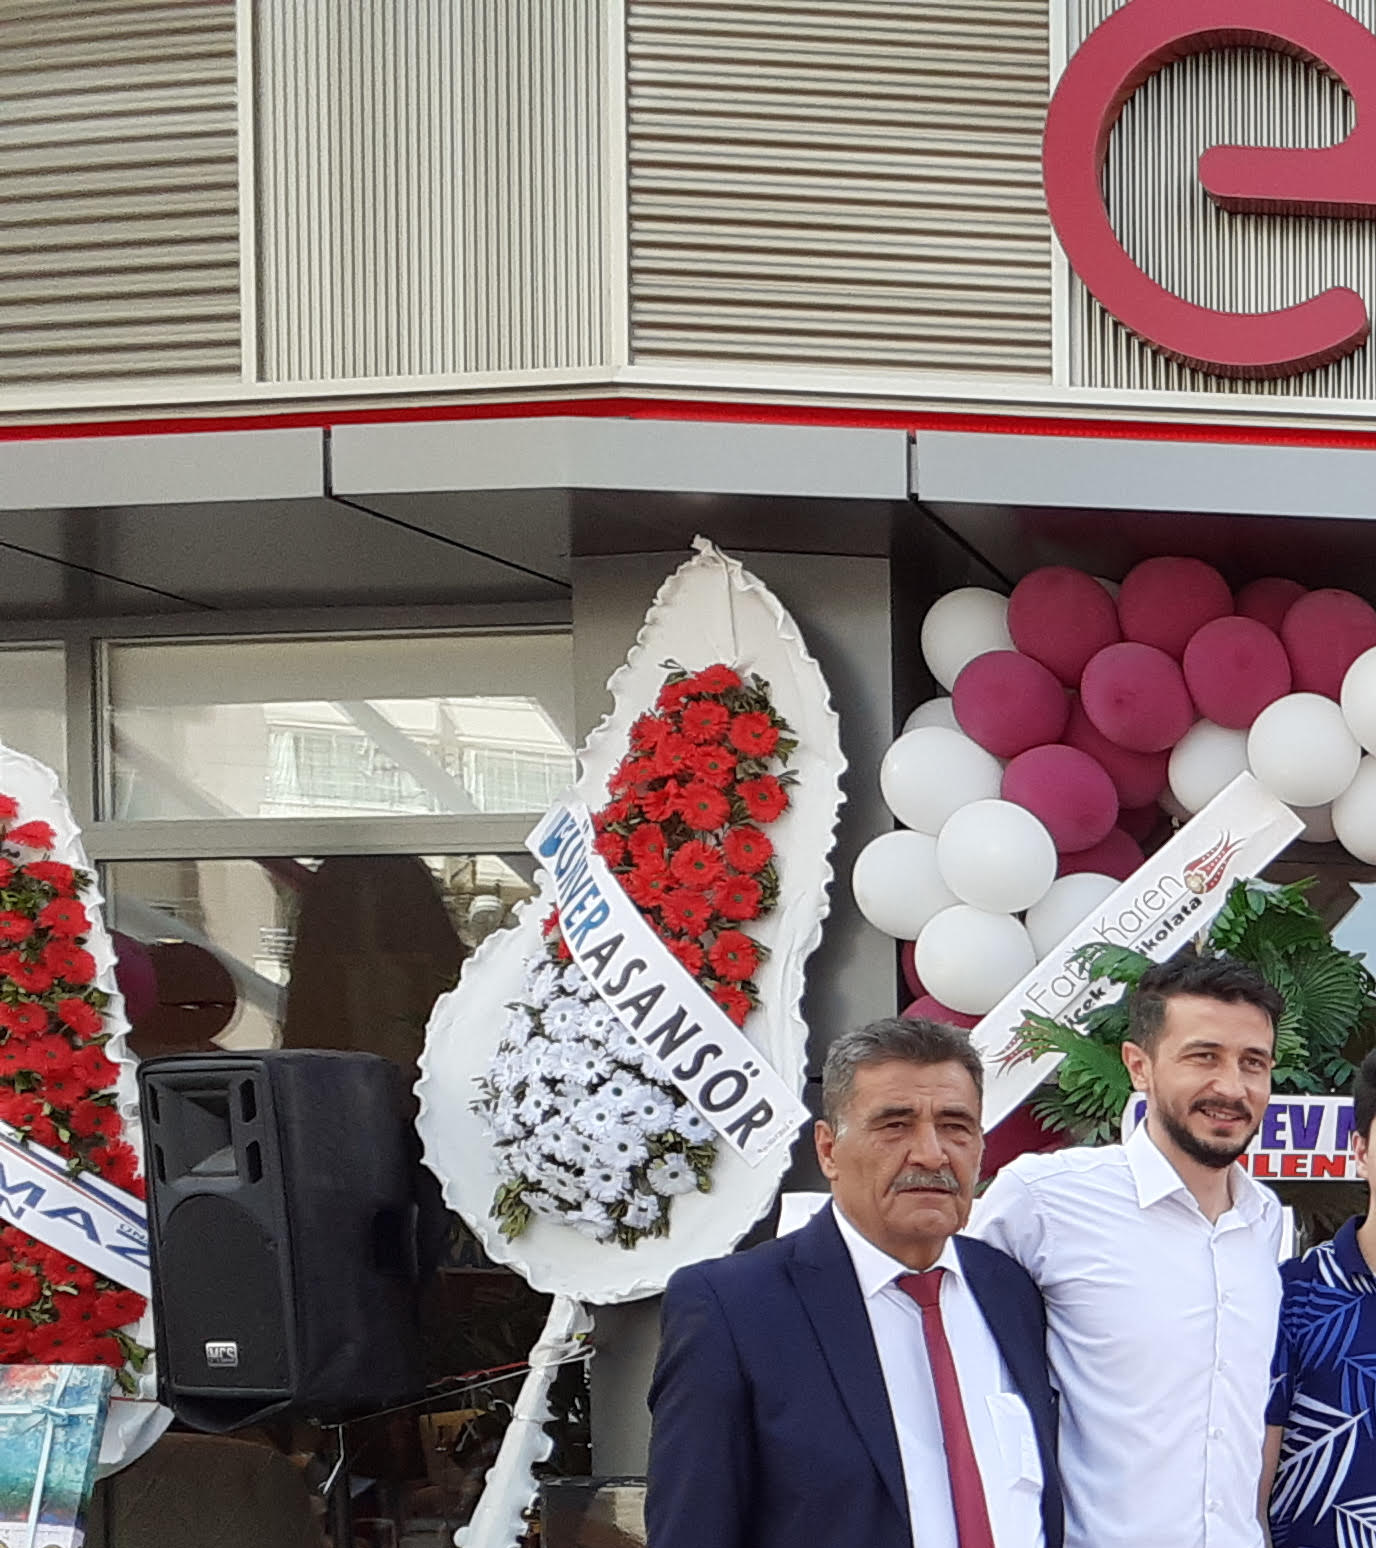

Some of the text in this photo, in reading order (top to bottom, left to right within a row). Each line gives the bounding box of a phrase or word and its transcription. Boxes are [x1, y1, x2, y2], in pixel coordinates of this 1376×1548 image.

[1092, 874, 1184, 945] Karen
[1137, 895, 1203, 957] ikolata
[580, 932, 775, 1150] ASANSÖR
